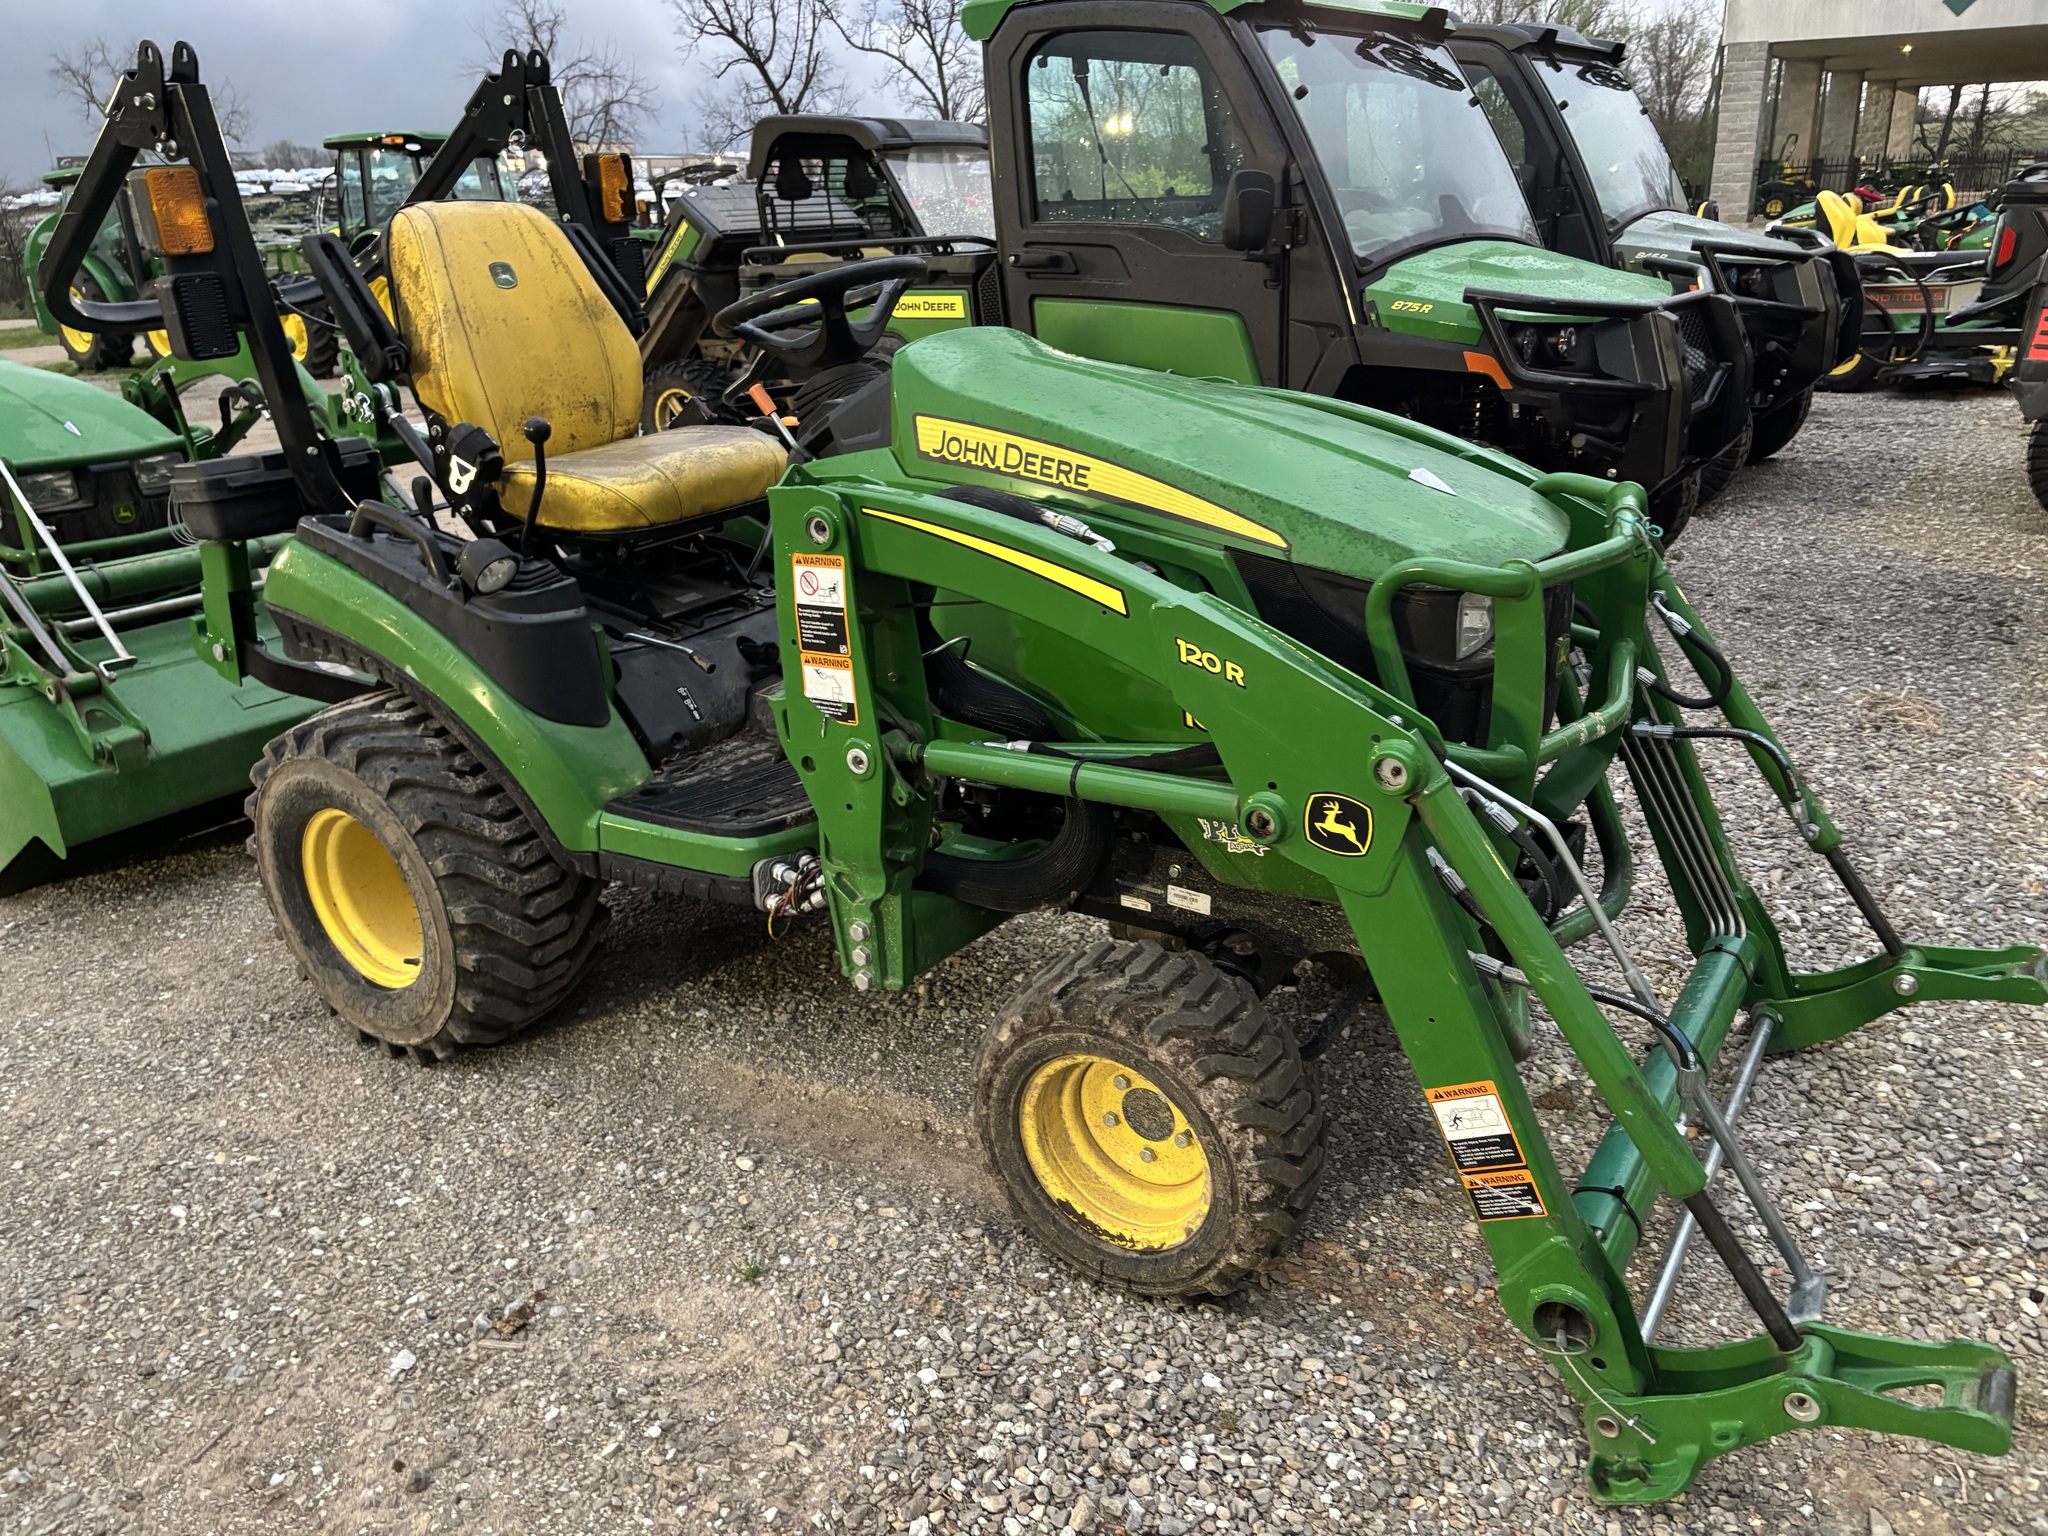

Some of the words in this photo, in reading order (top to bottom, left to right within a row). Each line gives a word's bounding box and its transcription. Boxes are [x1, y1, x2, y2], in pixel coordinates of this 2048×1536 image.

[1895, 292, 1943, 302] TOOS
[896, 302, 921, 310] JOHN
[923, 301, 956, 310] DEERE
[1391, 300, 1434, 314] 875R
[932, 430, 998, 466] JOHN
[1003, 442, 1091, 488] DEERE
[802, 556, 842, 567] WARNING
[810, 656, 850, 669] WARNING
[1175, 637, 1222, 675] 120
[1225, 660, 1247, 689] R
[1443, 1086, 1488, 1098] WARNING
[1480, 1174, 1525, 1185] WARNING
